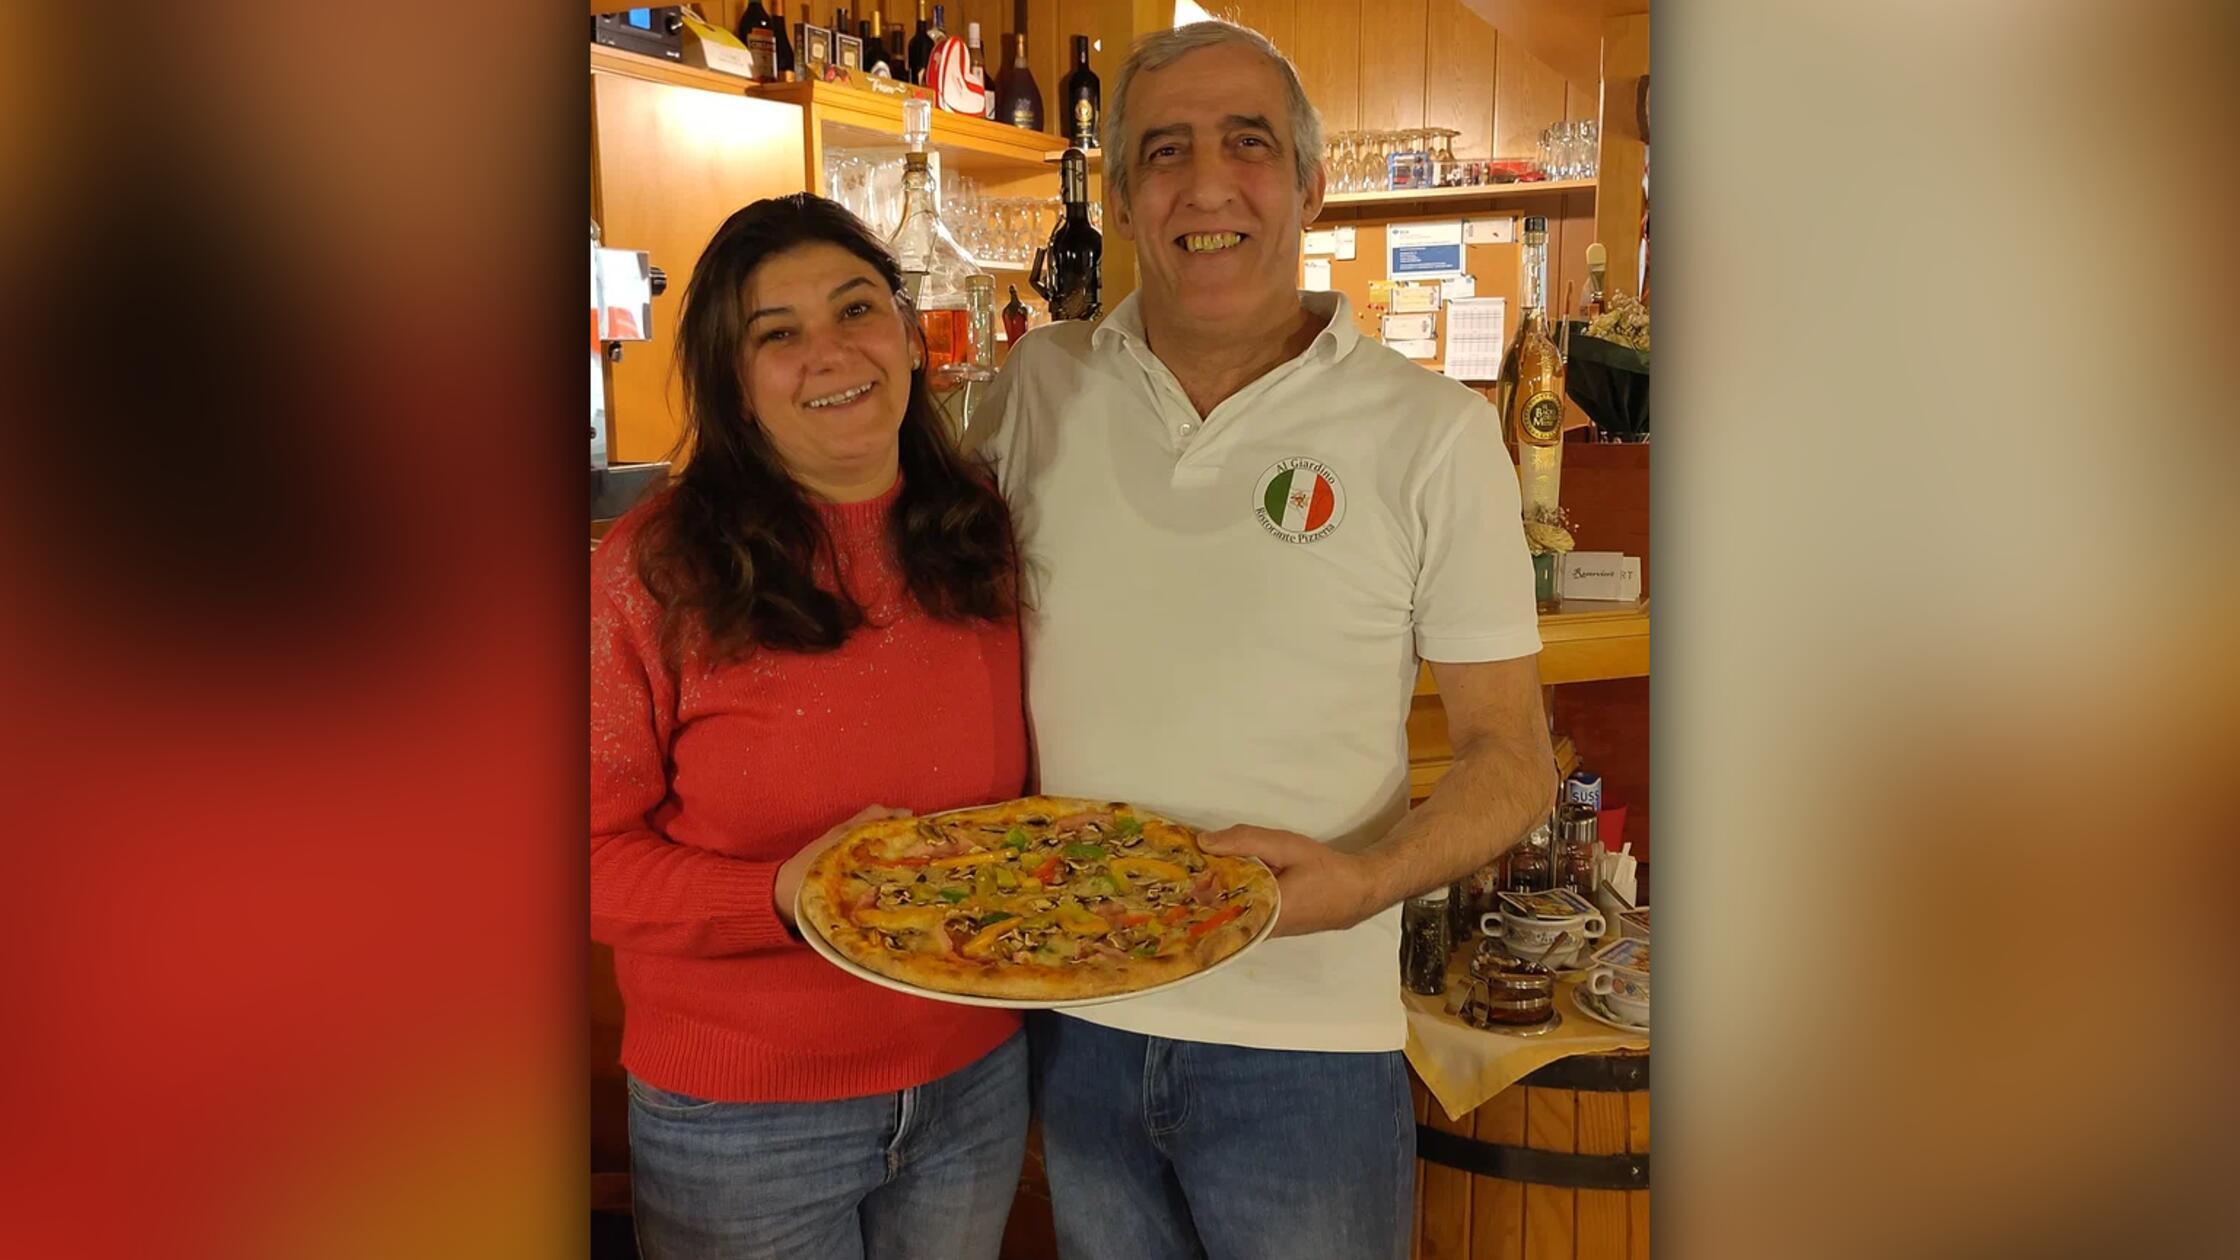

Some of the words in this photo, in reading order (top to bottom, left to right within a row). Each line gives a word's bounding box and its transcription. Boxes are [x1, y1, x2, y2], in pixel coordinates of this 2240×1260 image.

[1276, 461, 1288, 473] Al
[1290, 458, 1336, 485] Giardino
[1298, 522, 1336, 544] Pizzeria
